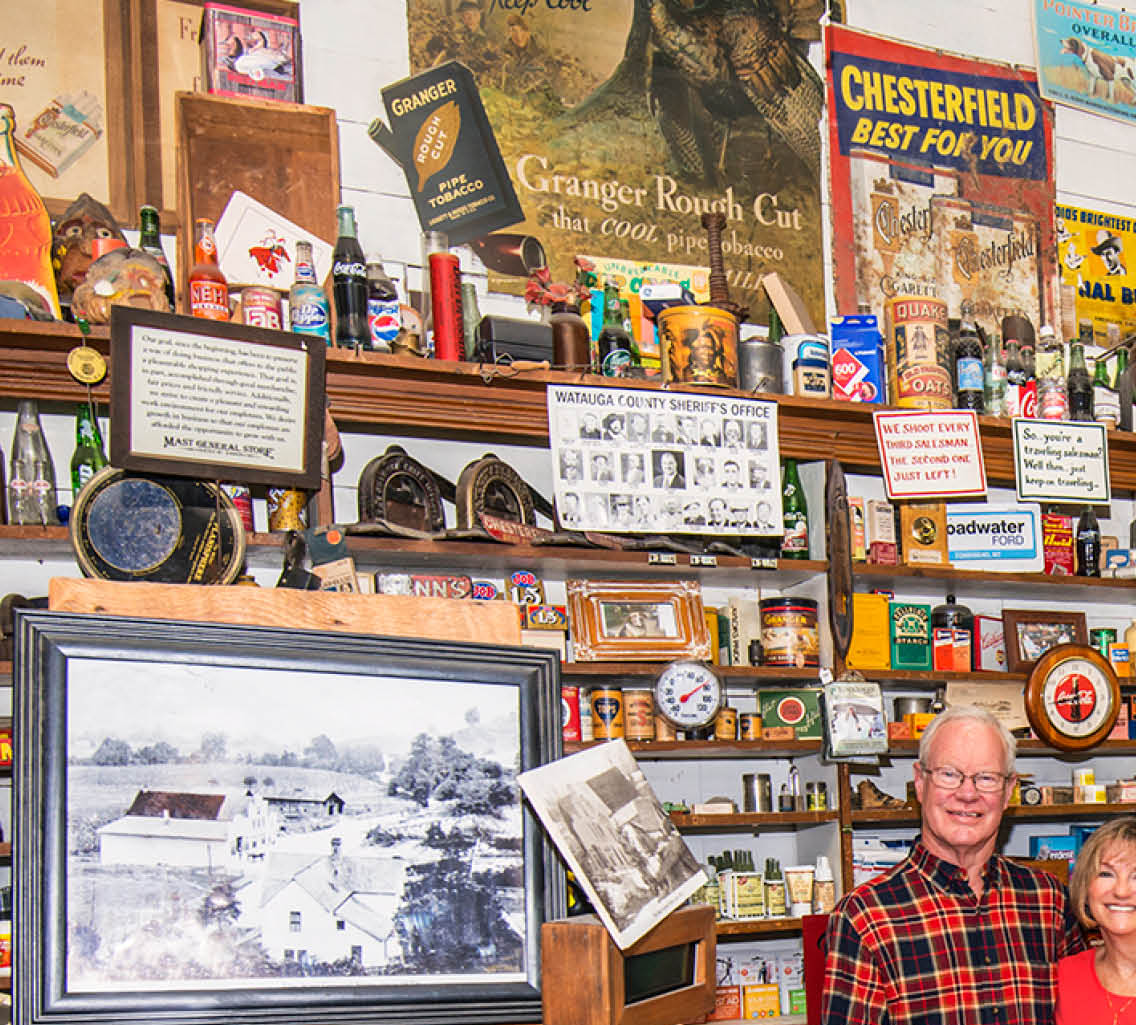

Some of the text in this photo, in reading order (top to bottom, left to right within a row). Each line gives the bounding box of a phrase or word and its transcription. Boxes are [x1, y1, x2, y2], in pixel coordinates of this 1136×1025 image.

[1044, 0, 1114, 29] POINTER
[392, 79, 457, 116] GRANGER
[840, 64, 1037, 132] CHESTERFIELD
[417, 116, 441, 163] ROUGH
[431, 130, 448, 160] CUT
[851, 116, 1034, 166] BEST FOR YOU
[438, 174, 468, 192] PIPE
[515, 153, 649, 211] Granger
[656, 175, 744, 224] Rough
[754, 193, 803, 231] Cut
[427, 180, 485, 208] TOBACCO
[1080, 211, 1131, 231] BRIGHTEST
[552, 206, 784, 261] that COOL pipe obacco
[835, 363, 855, 375] 600
[912, 378, 949, 395] OATS
[555, 391, 770, 418] WATAUGA COUNTY SHERIFF'S OFFICE
[882, 422, 970, 434] WE SHOOT EVERY
[164, 436, 275, 459] MAST GENERAL STORE
[885, 438, 969, 450] THIRD SALESMAN
[890, 454, 971, 465] THE SECOND ONE
[1024, 459, 1043, 470] Well
[894, 470, 922, 481] JUST
[992, 535, 1025, 546] FORD
[514, 572, 535, 584] JOB
[473, 585, 495, 598] JOB
